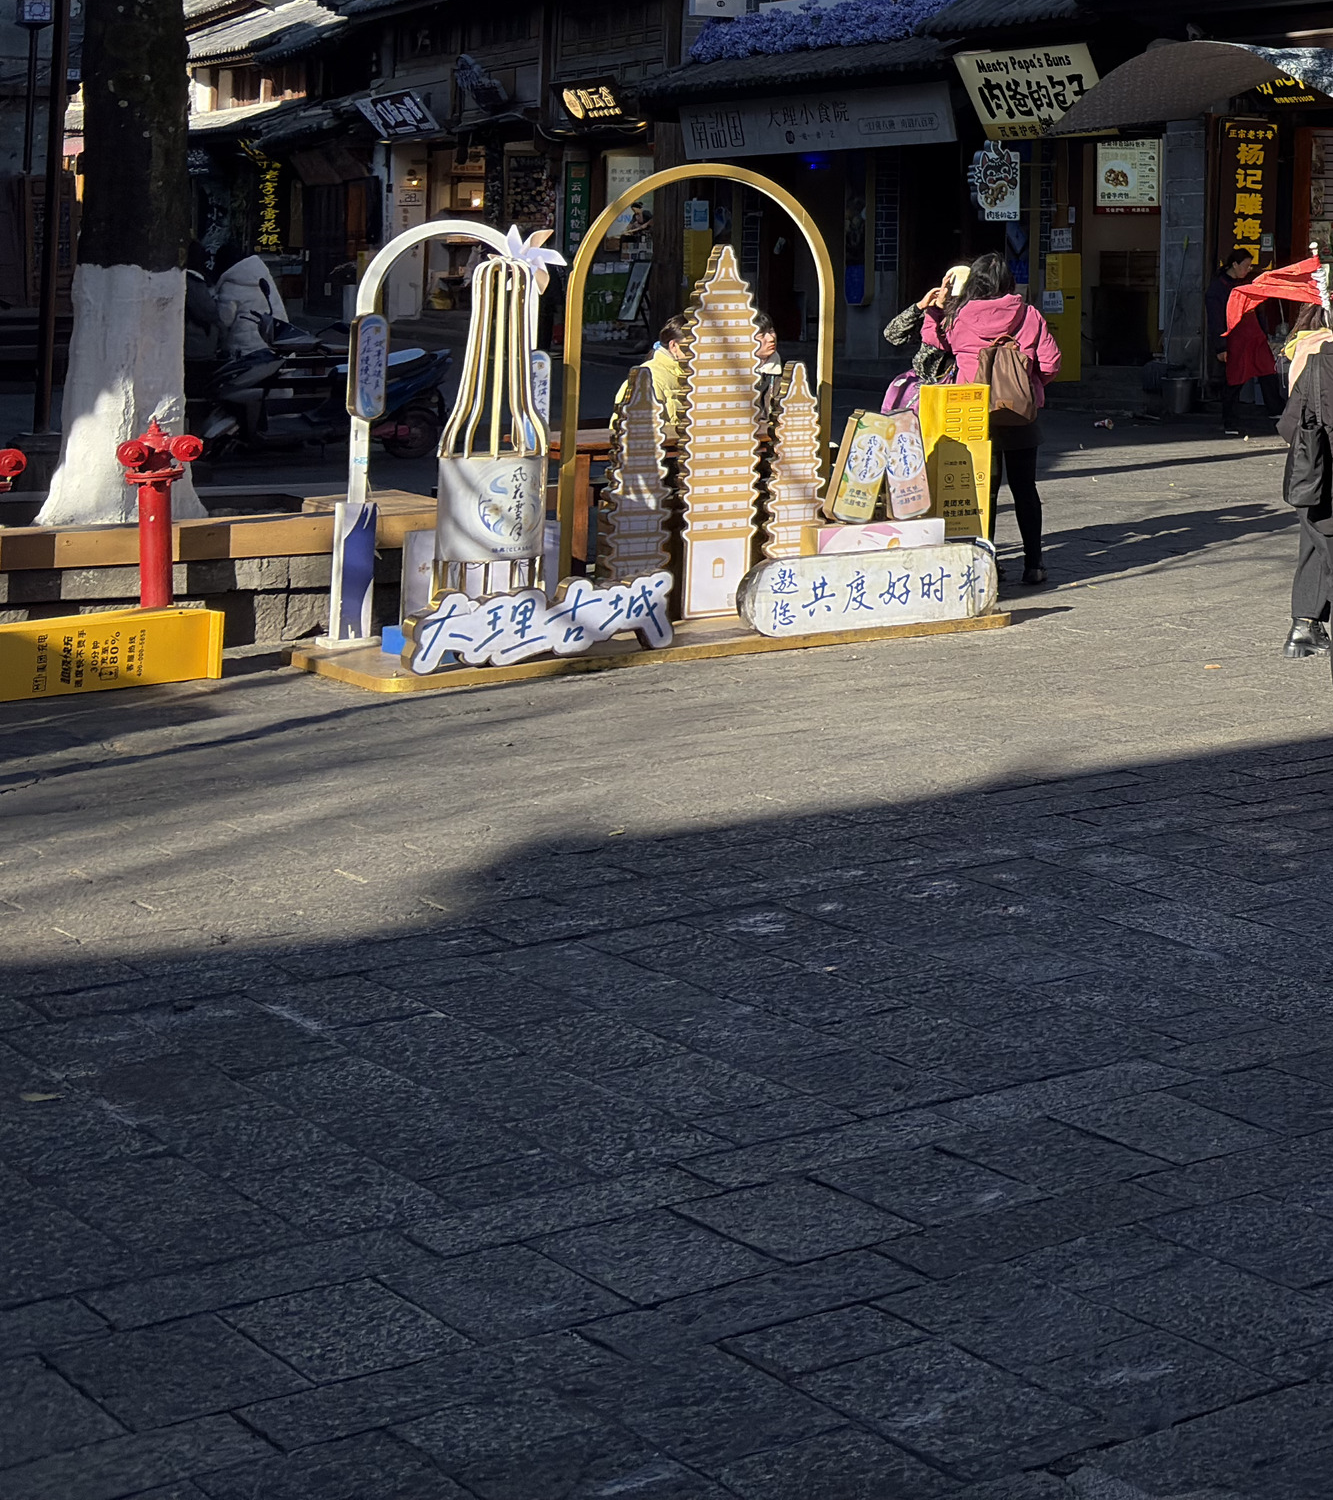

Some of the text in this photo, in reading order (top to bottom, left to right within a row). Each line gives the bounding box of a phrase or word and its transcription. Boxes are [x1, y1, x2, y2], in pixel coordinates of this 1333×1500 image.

[976, 53, 1071, 74] Meaty Papa's Buns
[978, 74, 1090, 120] 肉爸的包子
[767, 101, 850, 130] 大理小食院
[1228, 129, 1274, 140] 正宗老字号
[770, 567, 799, 631] 邀您
[801, 566, 986, 615] 共度好时光
[421, 580, 665, 661] 大理古城
[90, 640, 101, 674] 30分钟
[109, 631, 121, 665] 80%
